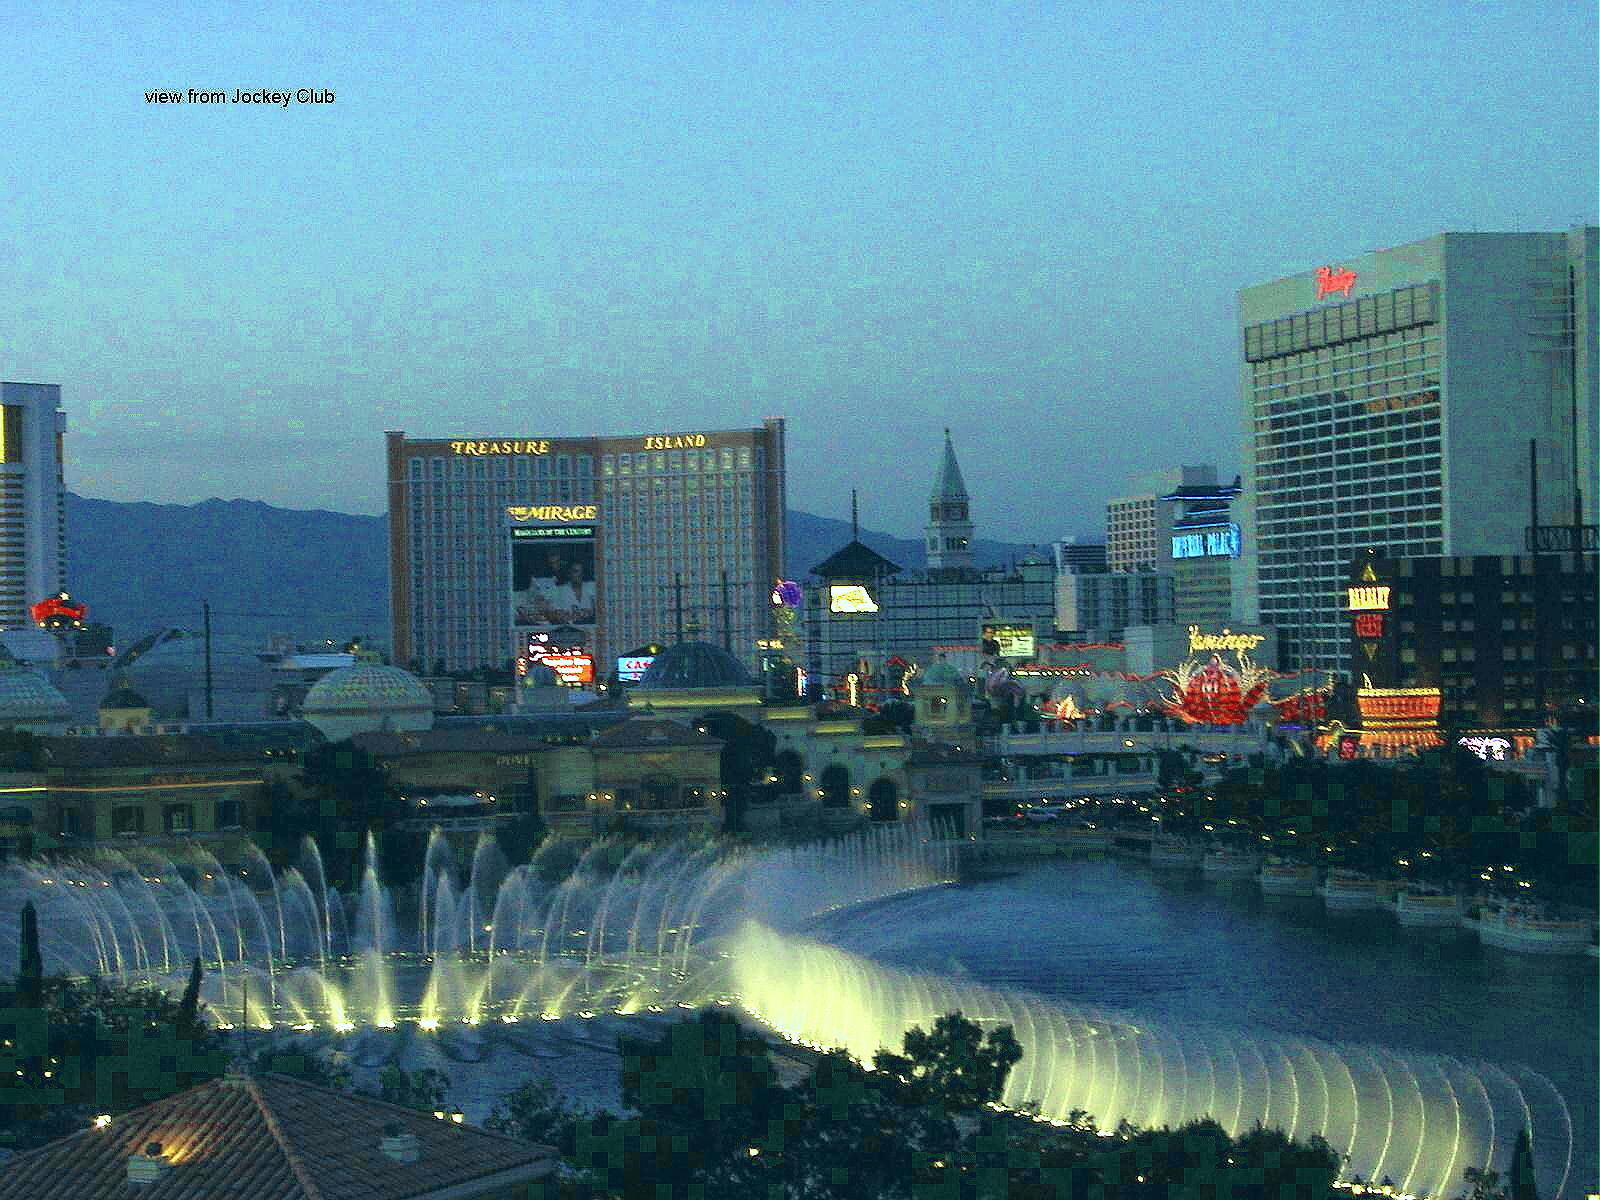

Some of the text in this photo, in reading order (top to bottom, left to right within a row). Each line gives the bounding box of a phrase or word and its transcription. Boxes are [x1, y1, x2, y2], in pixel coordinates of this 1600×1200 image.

[451, 434, 706, 456] TREASURE ISLAND
[528, 505, 597, 521] MIRAGE
